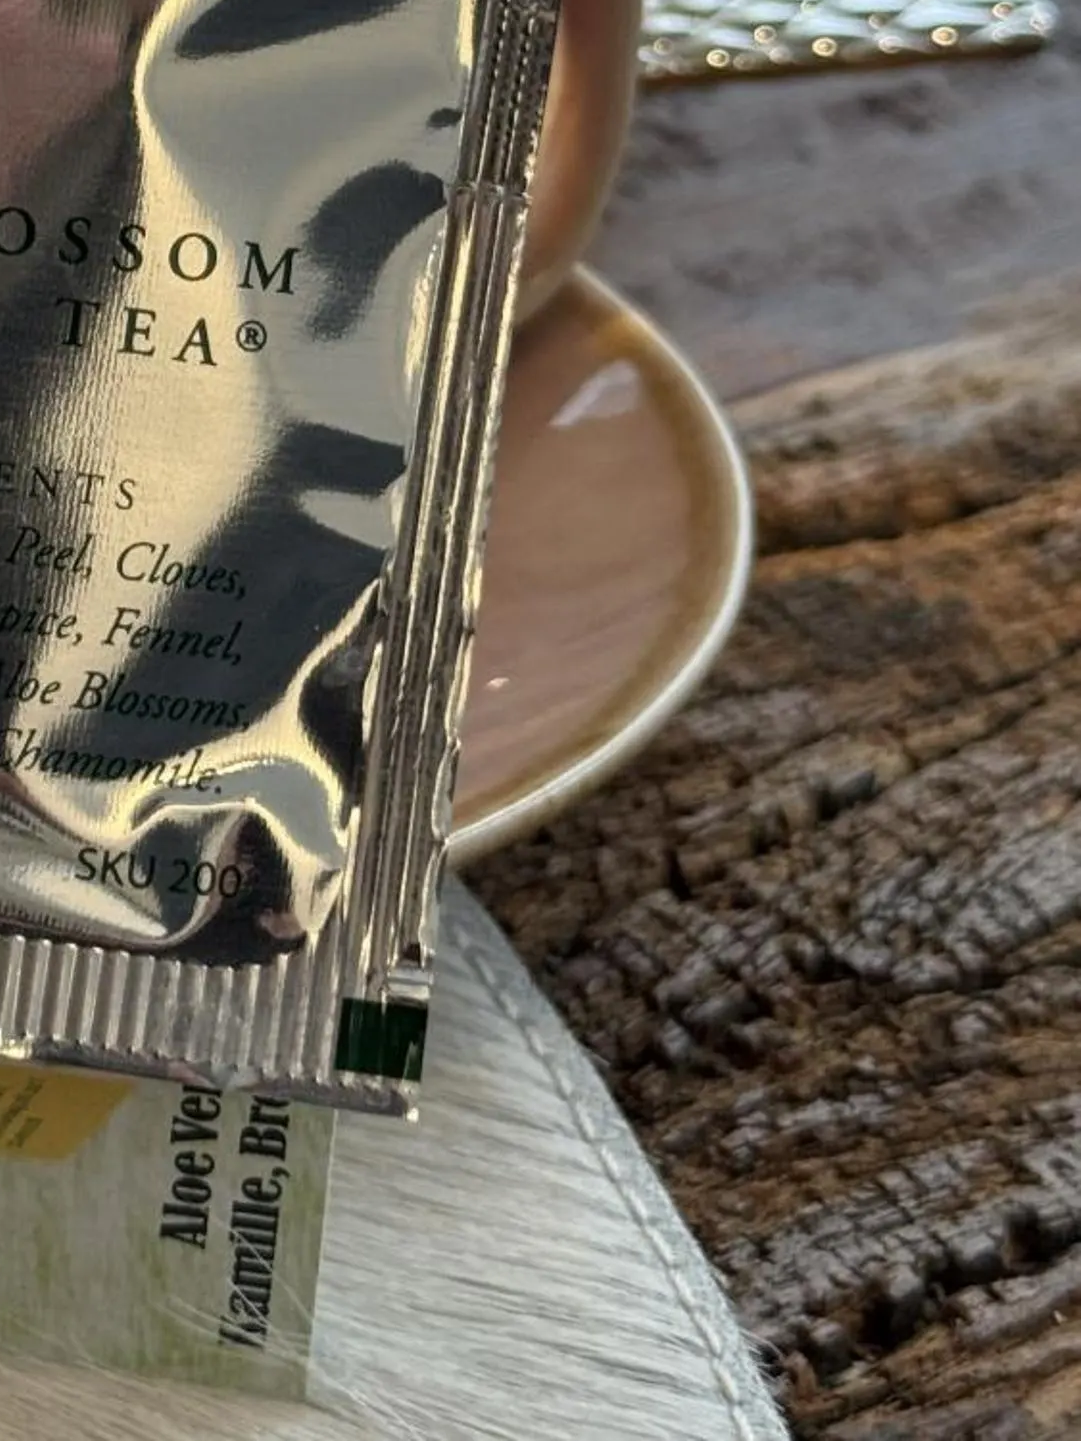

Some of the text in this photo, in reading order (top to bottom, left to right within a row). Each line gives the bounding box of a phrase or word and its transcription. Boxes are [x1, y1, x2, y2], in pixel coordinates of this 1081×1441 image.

[7, 525, 94, 579] Peel,
[116, 540, 246, 600] Cloves,
[102, 606, 243, 666] Fennel,
[71, 669, 252, 733] Blossoms,
[75, 846, 157, 890] SKU
[159, 1149, 217, 1250] Aloe
[217, 1165, 292, 1348] Kamille,
